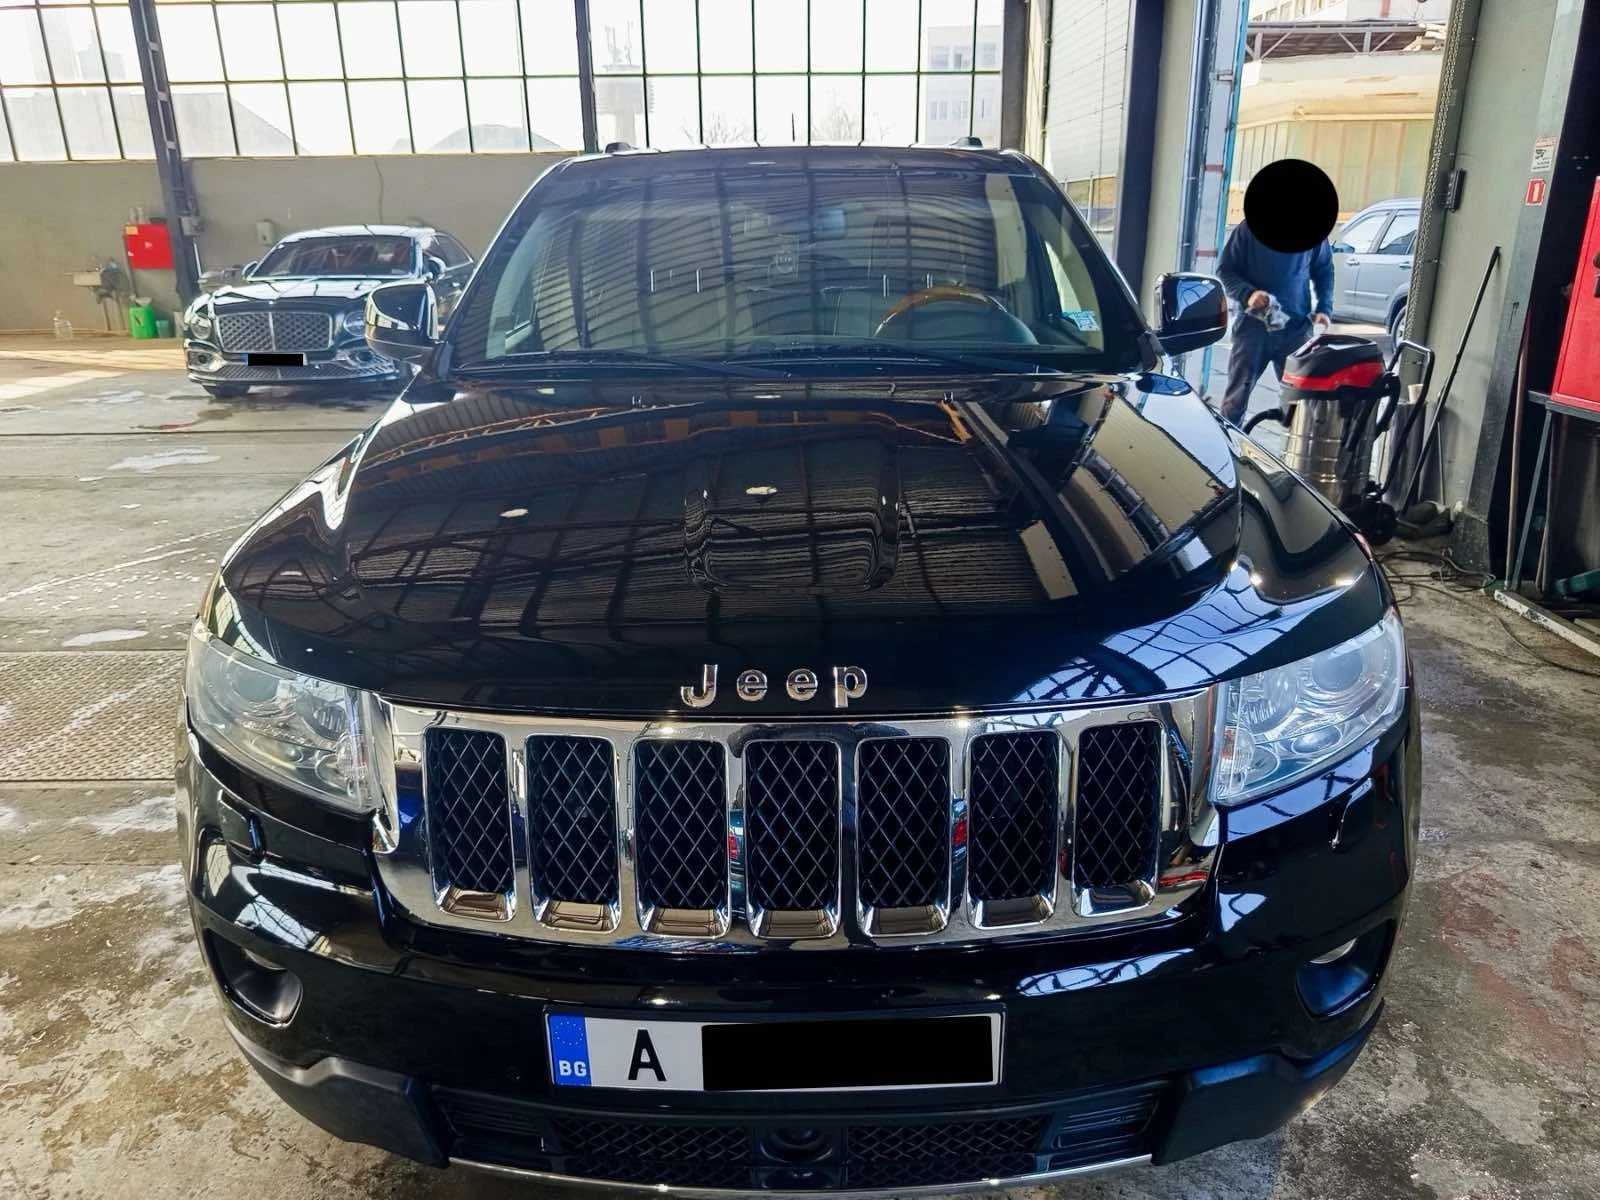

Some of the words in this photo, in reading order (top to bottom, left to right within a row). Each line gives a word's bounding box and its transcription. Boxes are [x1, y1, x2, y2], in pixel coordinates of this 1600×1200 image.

[680, 664, 868, 708] Jeep
[558, 1059, 588, 1077] BG
[627, 1028, 667, 1081] A
